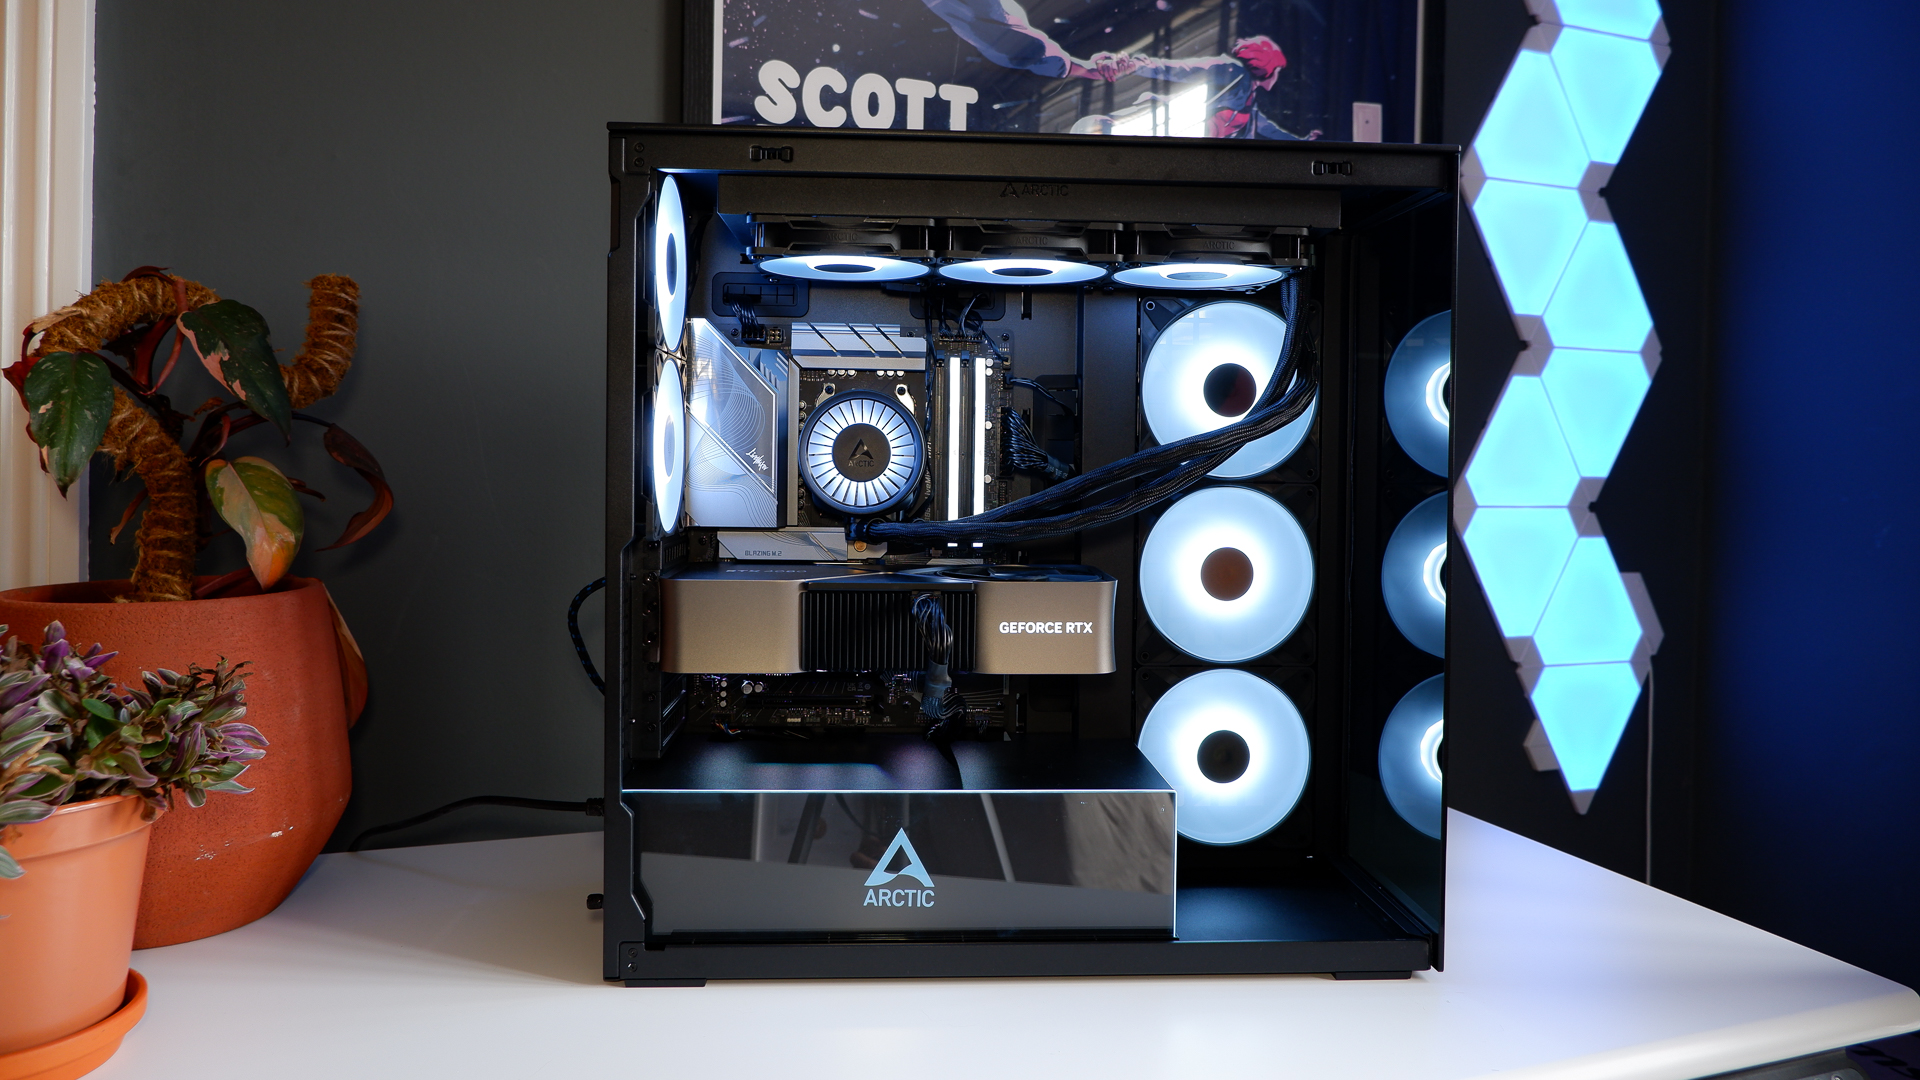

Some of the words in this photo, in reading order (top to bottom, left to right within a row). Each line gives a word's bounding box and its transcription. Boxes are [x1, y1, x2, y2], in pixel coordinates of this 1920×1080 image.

[754, 59, 979, 131] SCOTT
[1021, 183, 1068, 197] ARCTIC
[825, 232, 858, 242] ARCTIC
[1016, 236, 1048, 246] ARCTIC
[1203, 240, 1235, 250] ARCTIC
[848, 460, 874, 468] ARCTIC
[999, 621, 1063, 634] GEFORCE
[1065, 621, 1093, 634] RTX
[863, 888, 935, 908] ARCTIC
